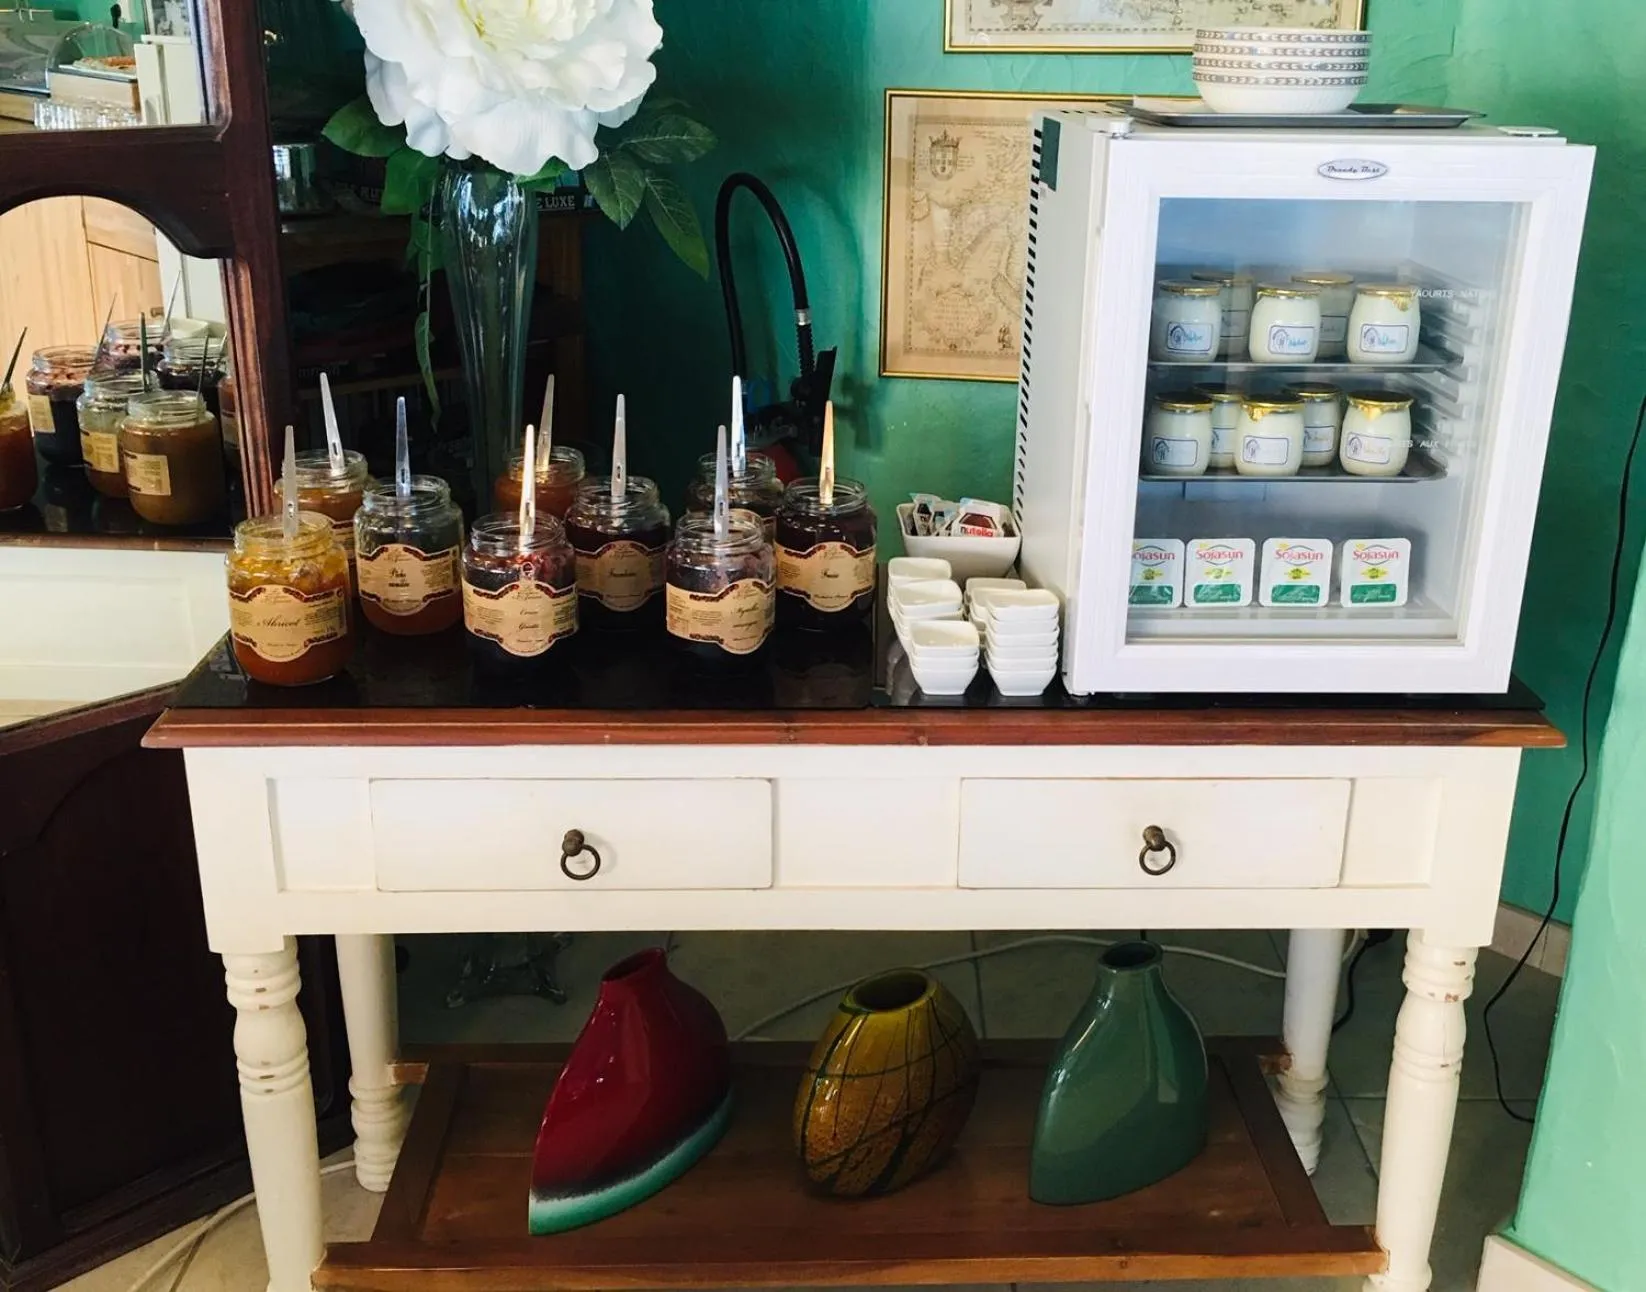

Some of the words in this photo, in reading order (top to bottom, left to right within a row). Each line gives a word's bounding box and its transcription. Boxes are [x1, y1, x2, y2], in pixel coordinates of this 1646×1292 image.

[545, 195, 575, 209] LUXE
[1131, 550, 1176, 562] ojasun
[1196, 549, 1244, 561] Sojasun
[1275, 549, 1324, 561] Sojasun
[1353, 549, 1399, 561] Sojasun
